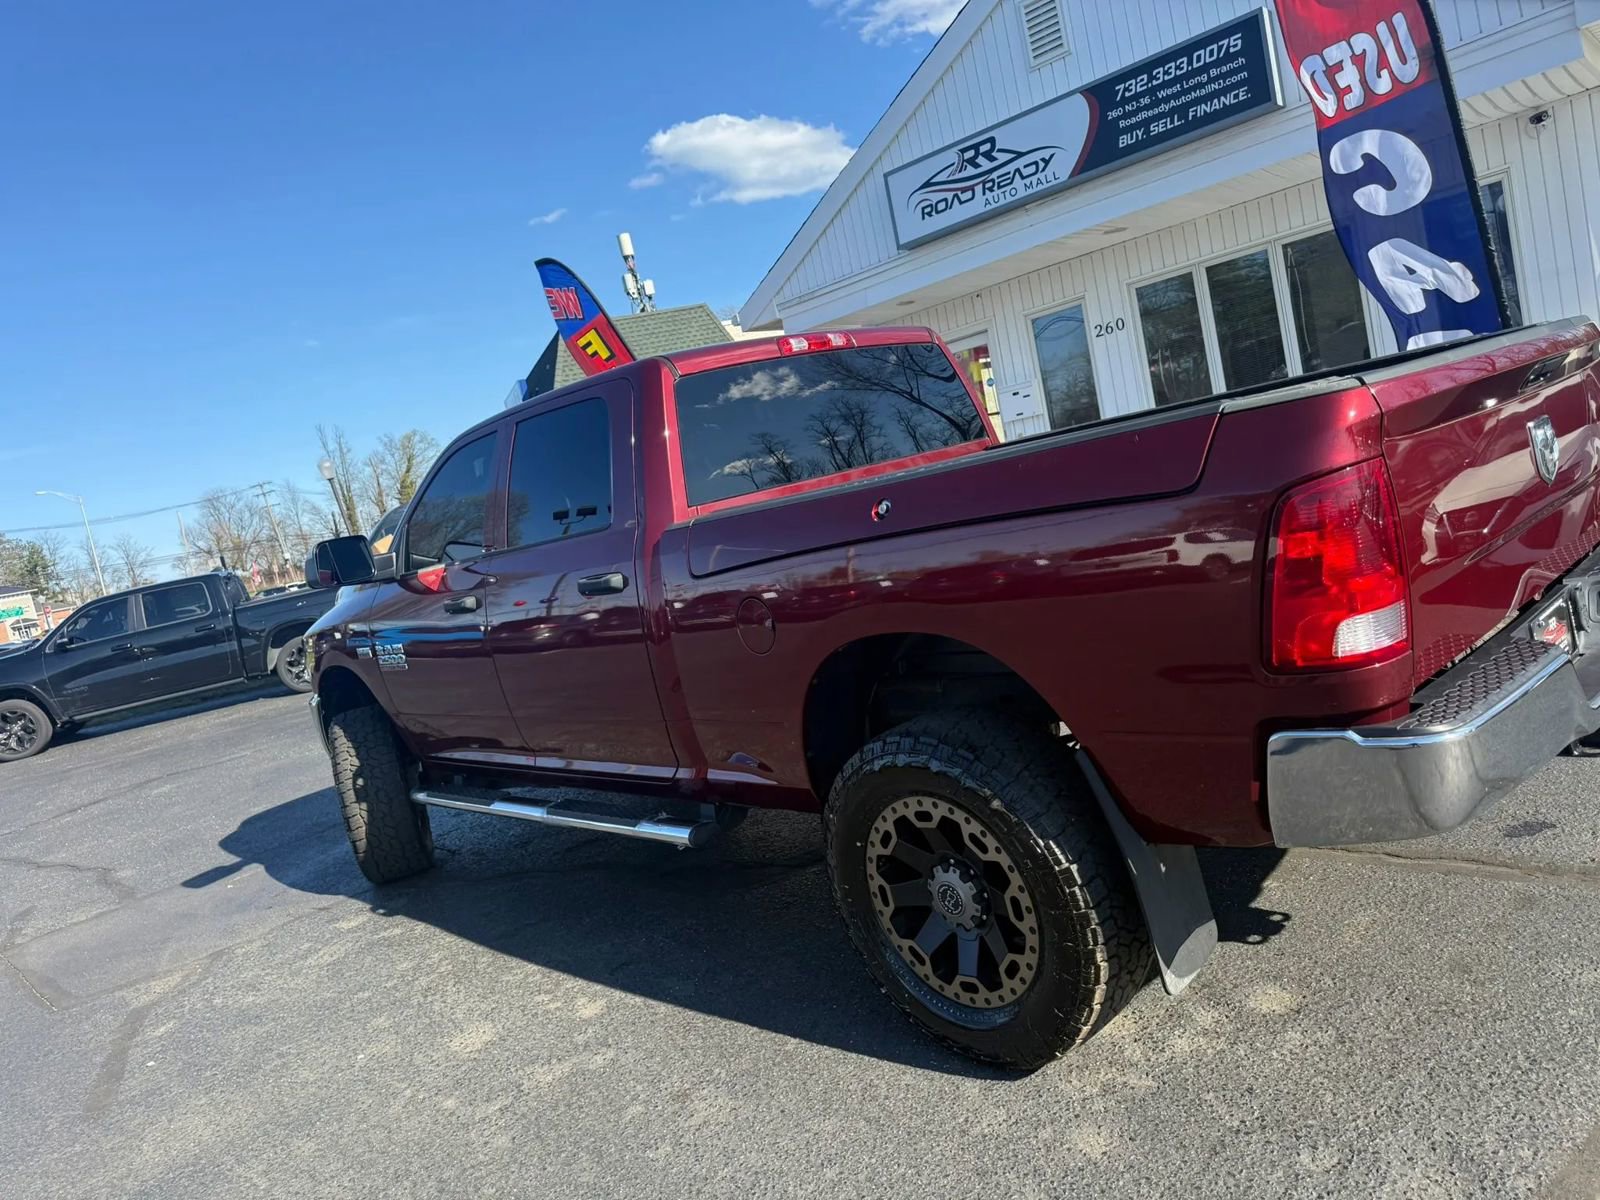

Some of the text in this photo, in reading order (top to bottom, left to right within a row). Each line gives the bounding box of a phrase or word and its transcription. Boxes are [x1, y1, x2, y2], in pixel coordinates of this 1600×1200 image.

[1107, 57, 1246, 120] 260 NJ-36 West Long Branch
[1115, 33, 1242, 101] 732.333.0075
[1119, 71, 1248, 129] RoadReadyAutoMallNJ.com
[1119, 86, 1251, 148] BUY. SELL. FINANCE.
[955, 136, 999, 173] RR
[921, 152, 1056, 221] ROAD READY
[984, 171, 1060, 209] AUTO MALL
[1094, 318, 1125, 338] 260
